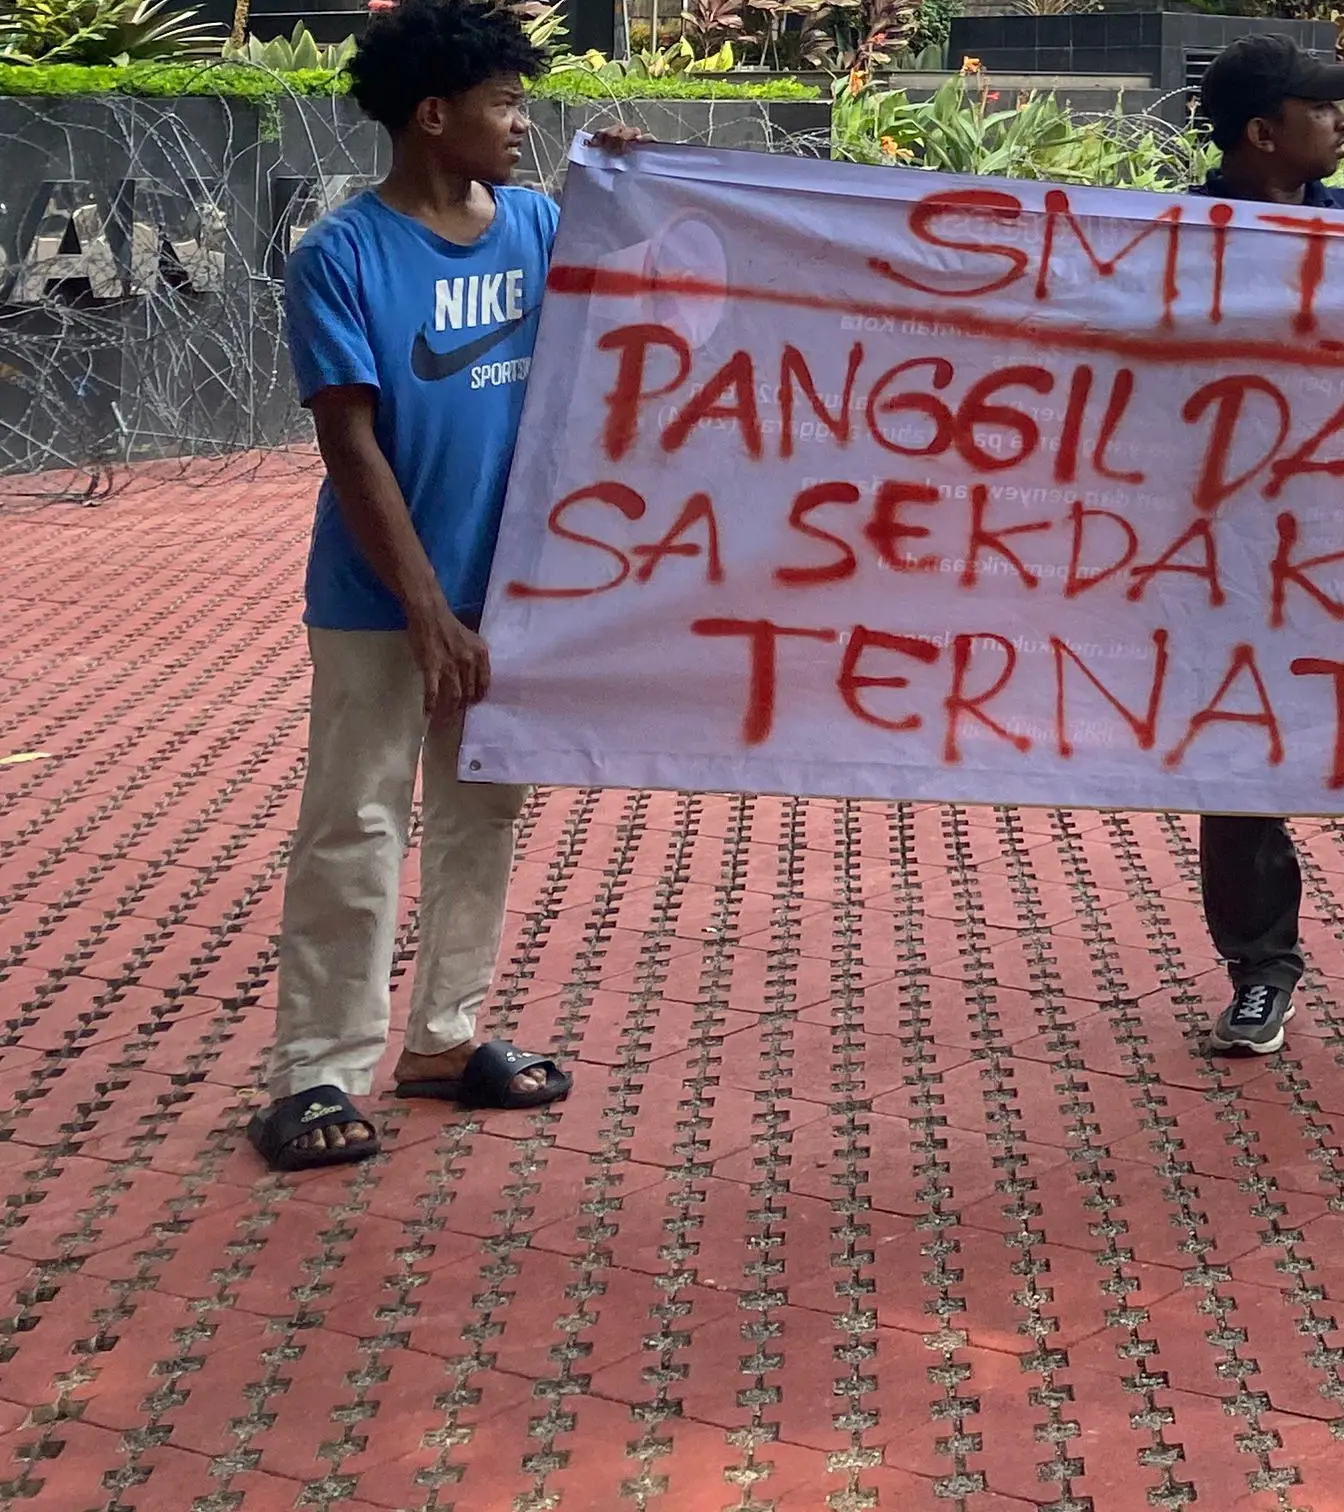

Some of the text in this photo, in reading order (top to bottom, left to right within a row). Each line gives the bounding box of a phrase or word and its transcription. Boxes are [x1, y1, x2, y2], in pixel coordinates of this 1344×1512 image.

[435, 269, 524, 332] NIKE
[506, 482, 724, 598] SA
[774, 482, 1224, 608] SEKDA
